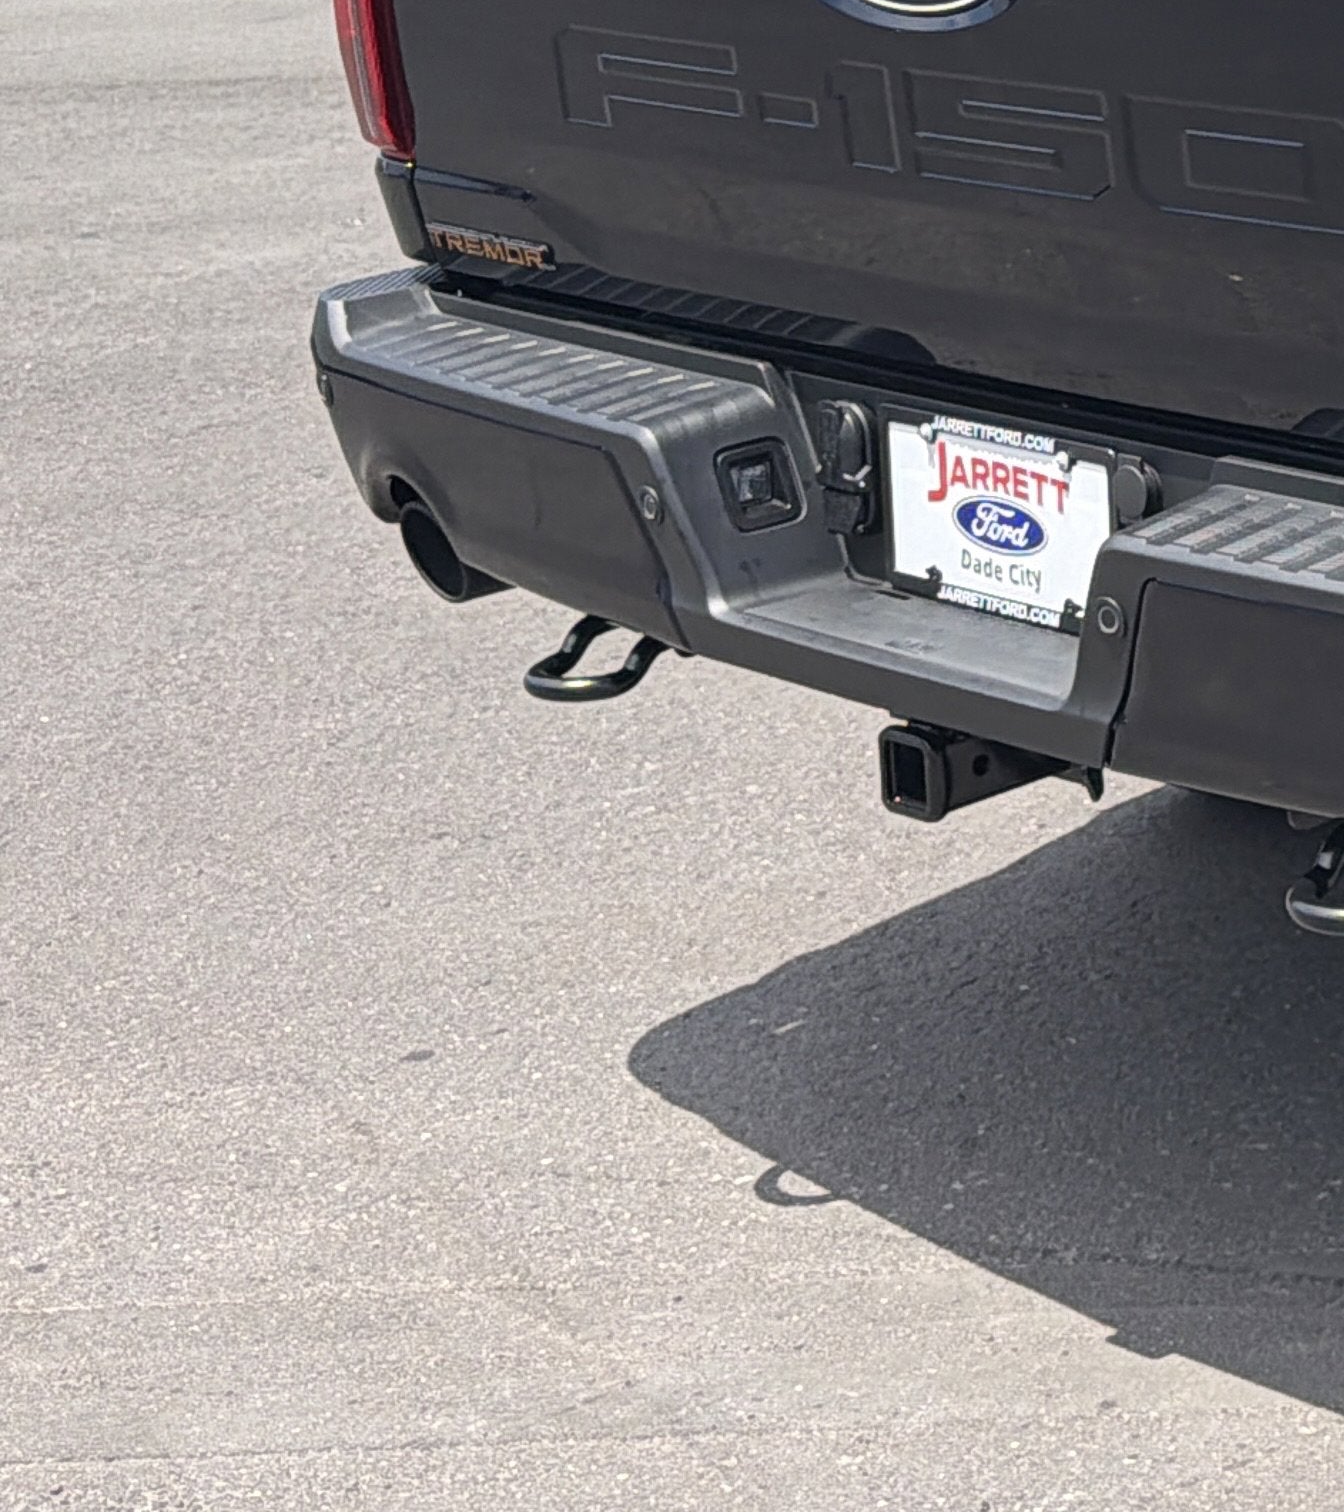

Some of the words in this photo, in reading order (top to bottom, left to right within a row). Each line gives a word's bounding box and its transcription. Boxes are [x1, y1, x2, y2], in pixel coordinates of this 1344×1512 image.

[429, 227, 546, 272] TREMOR
[930, 414, 1056, 455] JARRETTFORD.COM
[927, 440, 1070, 515] JARRETT
[970, 501, 1031, 548] Ford
[961, 548, 1003, 583] Dade
[1008, 563, 1043, 594] City
[936, 585, 1062, 628] JARRETTFORD.COM
